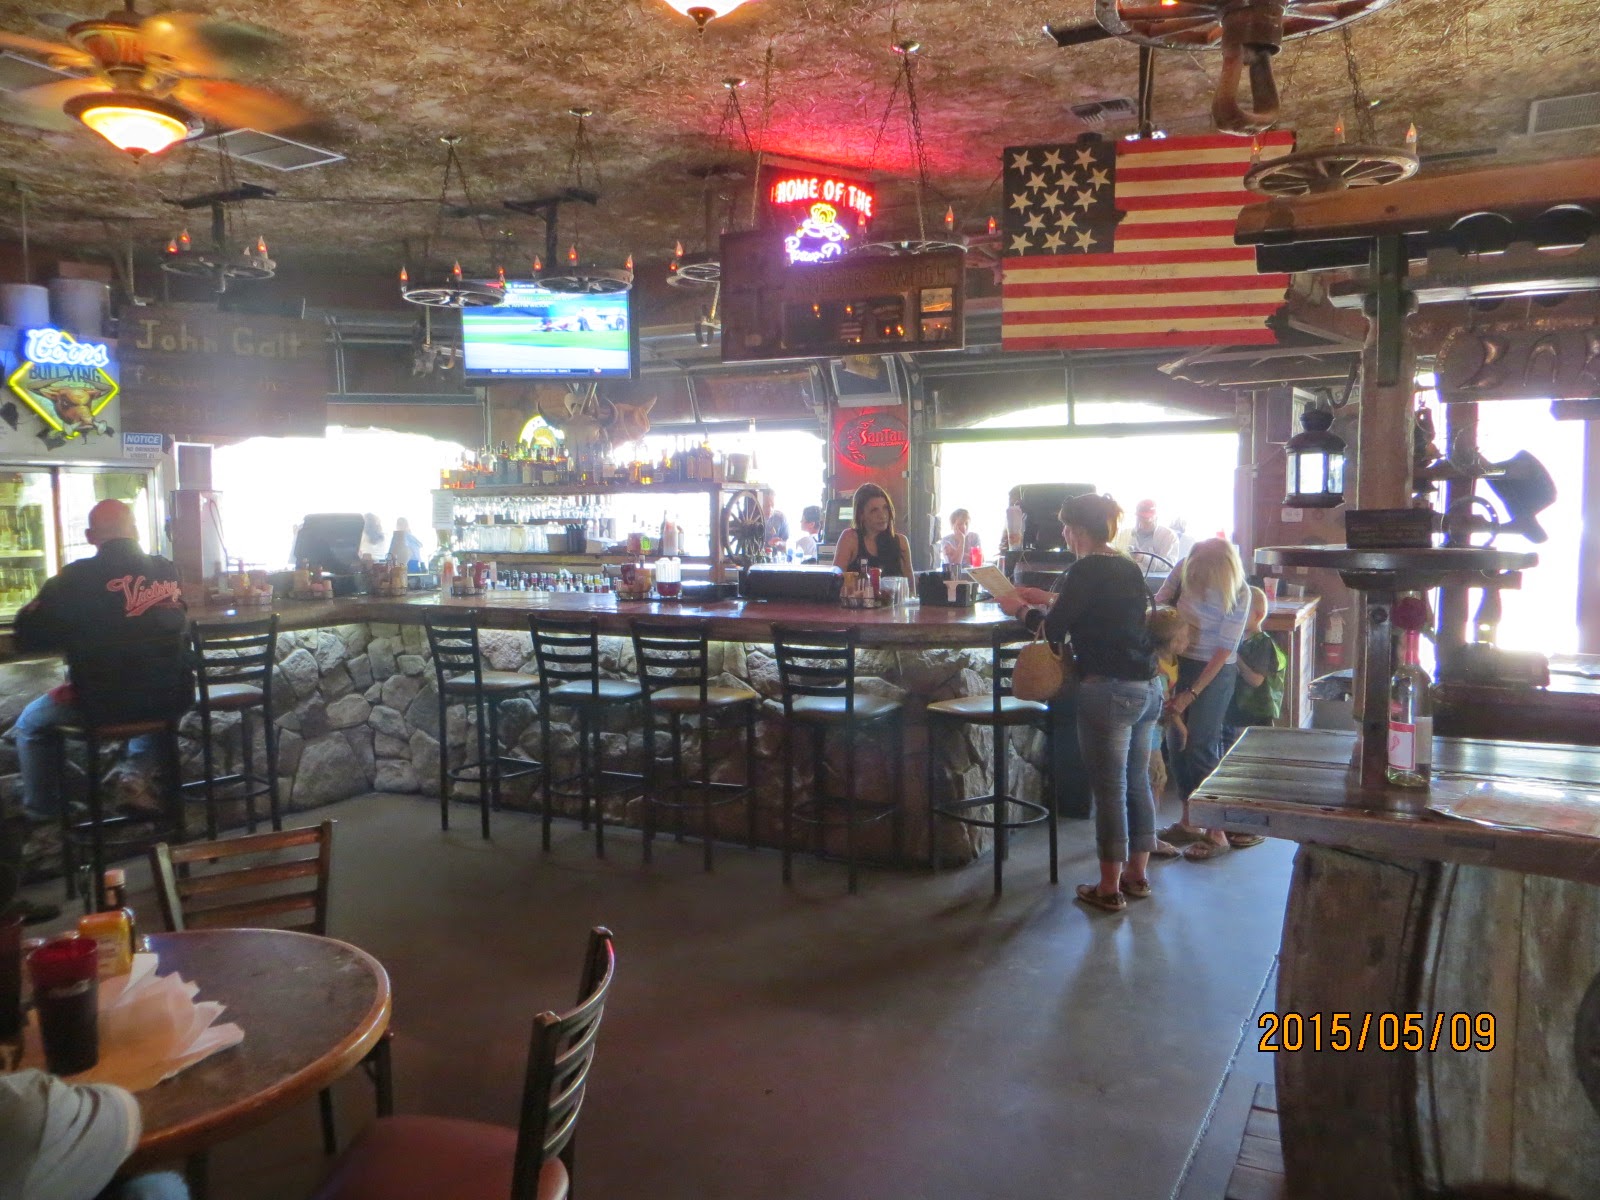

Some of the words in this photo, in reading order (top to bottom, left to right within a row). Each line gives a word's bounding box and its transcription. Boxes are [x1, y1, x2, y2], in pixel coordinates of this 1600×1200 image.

[775, 178, 819, 203] HOME
[823, 180, 845, 202] OF
[848, 186, 873, 217] THE
[25, 328, 110, 367] Coors
[135, 319, 219, 353] John
[232, 326, 302, 359] Galt
[29, 365, 62, 380] BULL
[67, 367, 101, 383] XING
[127, 435, 159, 444] NOTICE
[861, 428, 907, 446] SanTan
[106, 575, 181, 617] Victory
